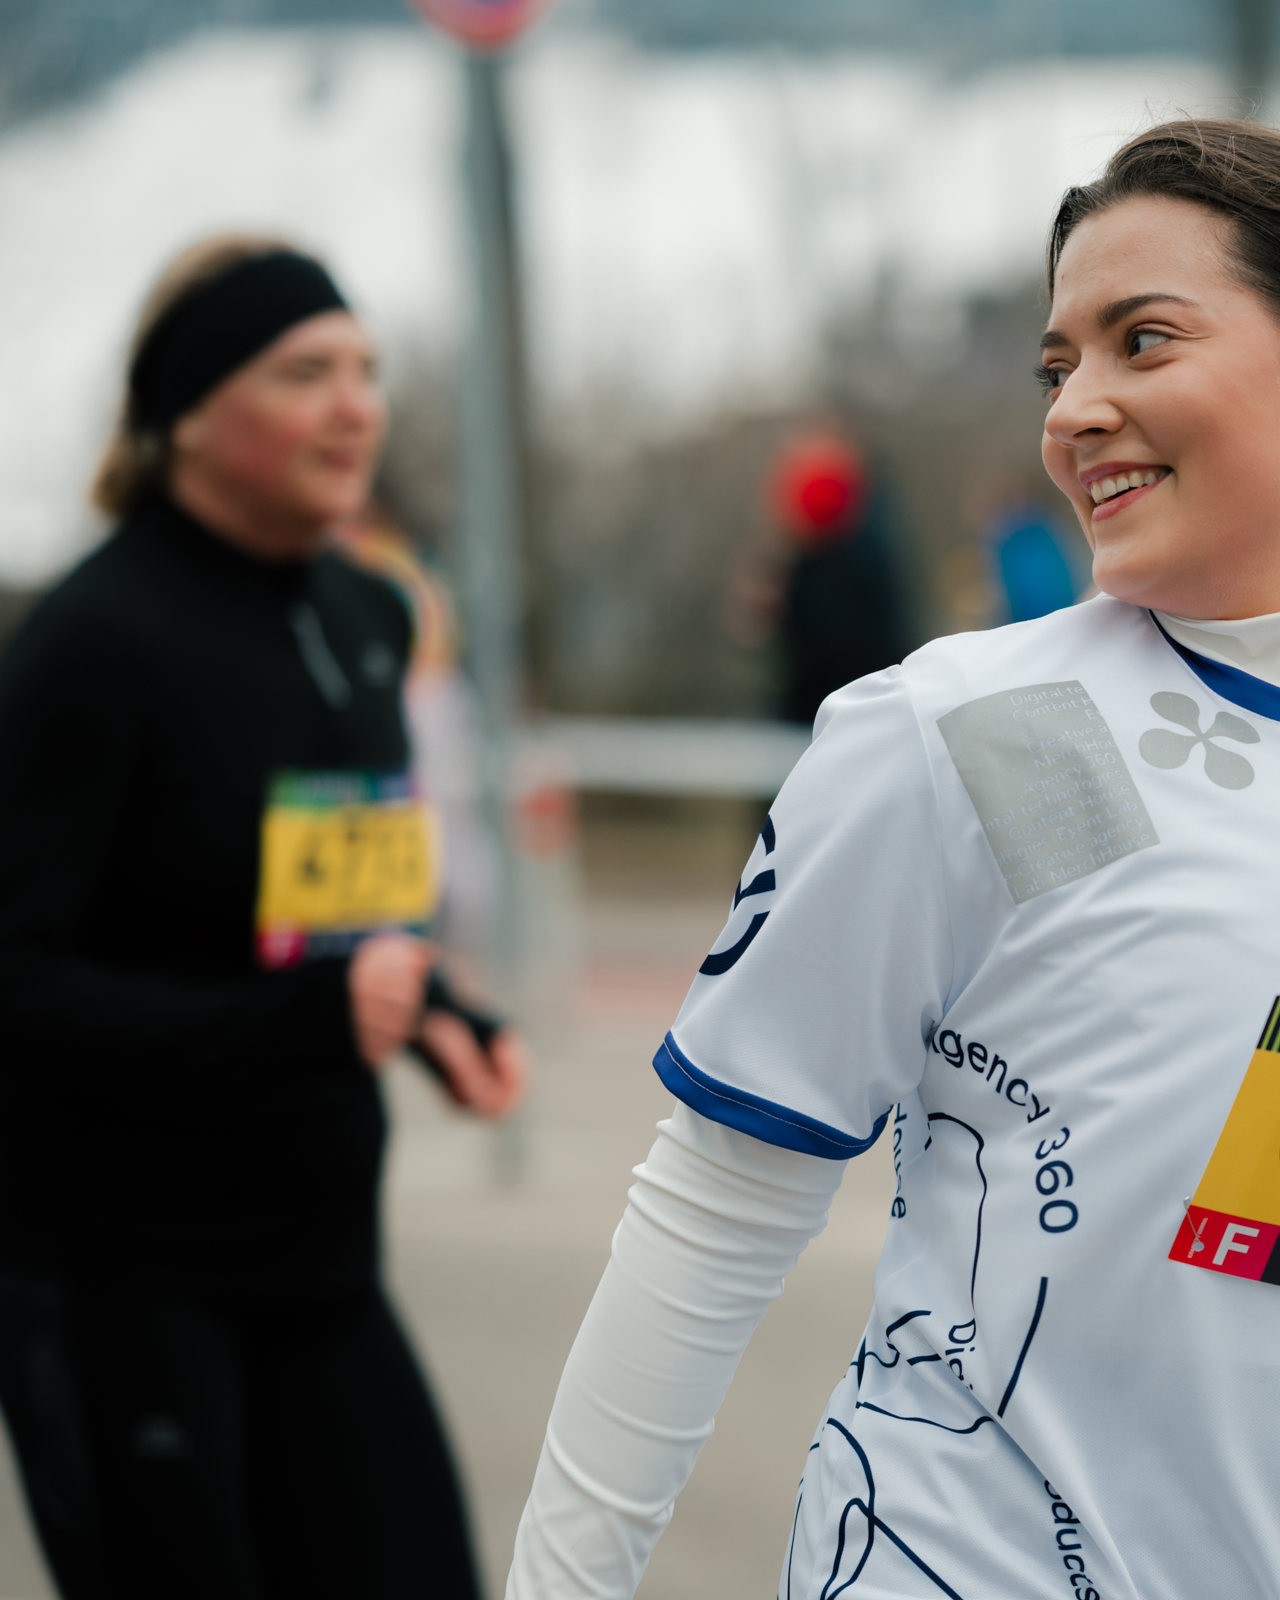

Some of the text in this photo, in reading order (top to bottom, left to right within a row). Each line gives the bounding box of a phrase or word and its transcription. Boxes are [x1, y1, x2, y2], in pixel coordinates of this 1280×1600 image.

[1009, 687, 1063, 706] Digital
[1012, 699, 1080, 722] Content
[1027, 726, 1095, 754] Creative
[1021, 769, 1123, 817] technologies
[1023, 752, 1116, 796] Agency 360
[1008, 784, 1130, 841] Content House
[1055, 813, 1104, 842] Event
[1105, 798, 1138, 819] Lab
[1013, 833, 1151, 900] Lab MerchHouse
[1016, 842, 1086, 877] Creative
[1090, 817, 1143, 847] agency
[1035, 1126, 1080, 1234] 360
[1211, 1222, 1260, 1266] F
